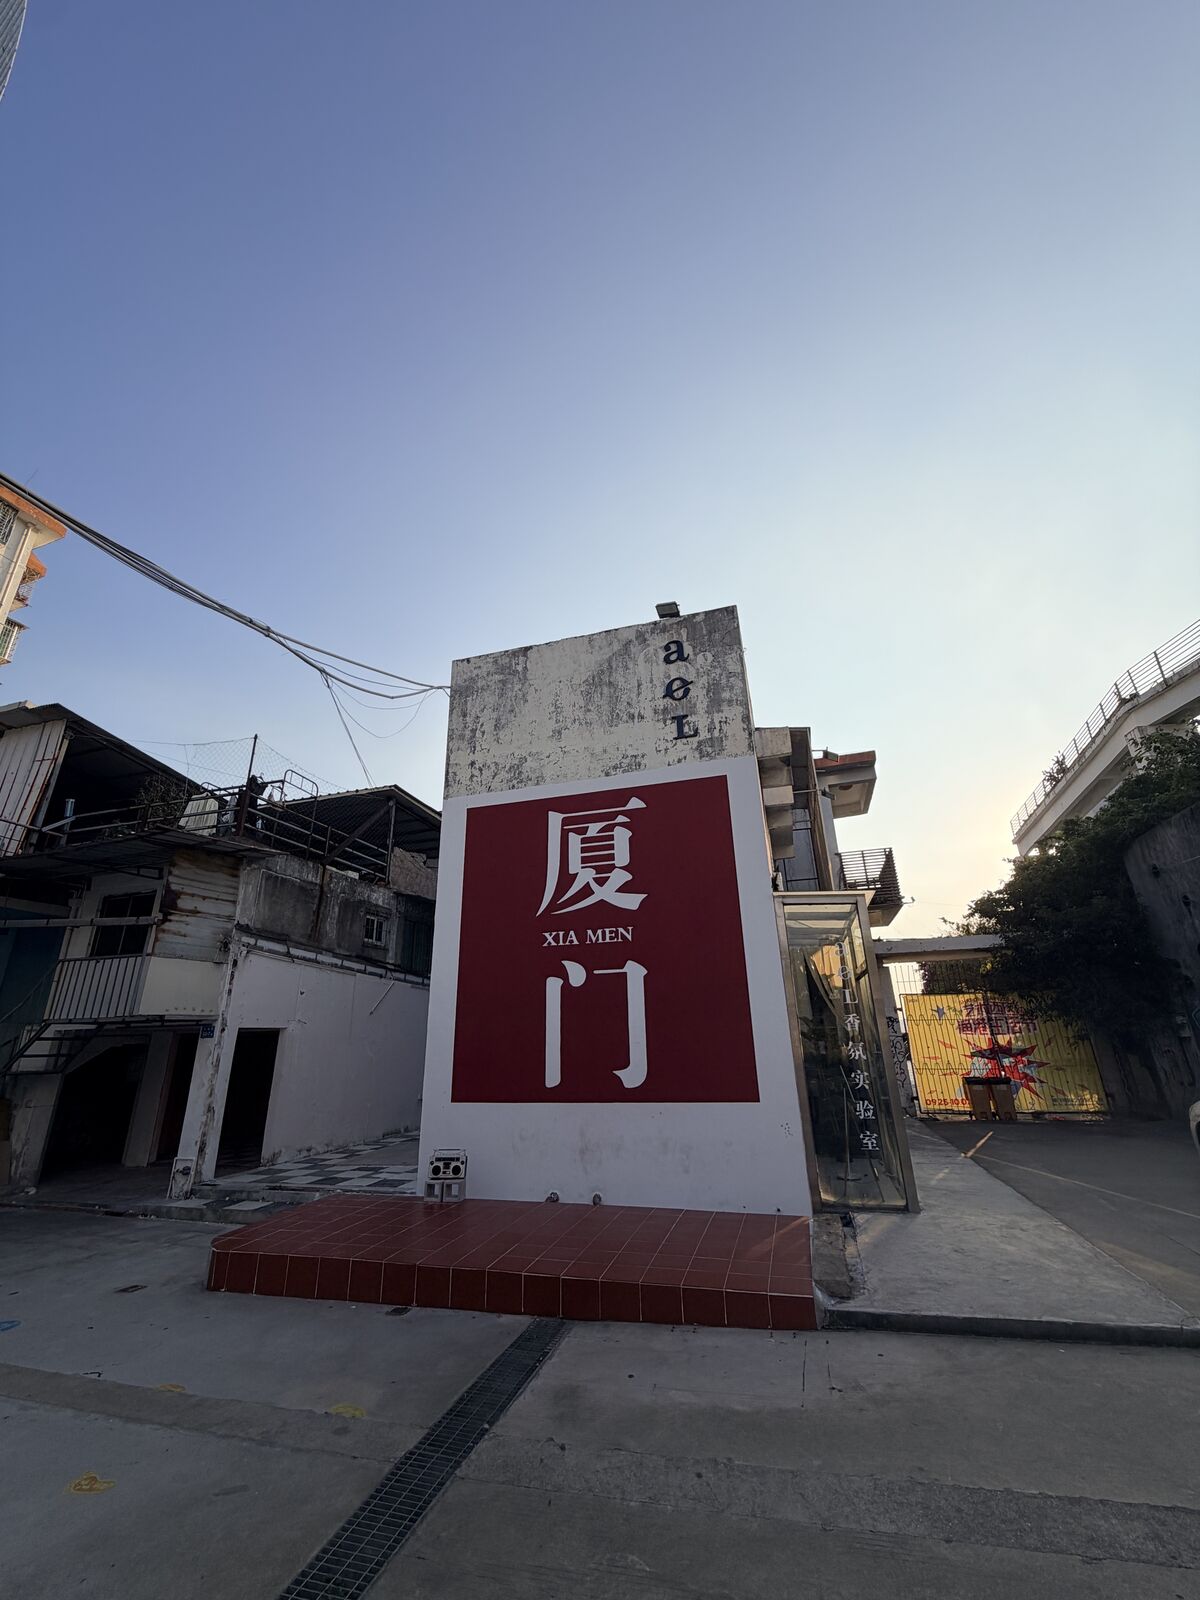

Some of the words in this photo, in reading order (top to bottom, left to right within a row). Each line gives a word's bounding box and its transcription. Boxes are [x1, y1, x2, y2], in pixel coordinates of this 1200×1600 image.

[536, 796, 649, 918] 厦
[542, 930, 580, 947] XIA
[586, 926, 634, 944] MEN
[545, 959, 649, 1089] 门
